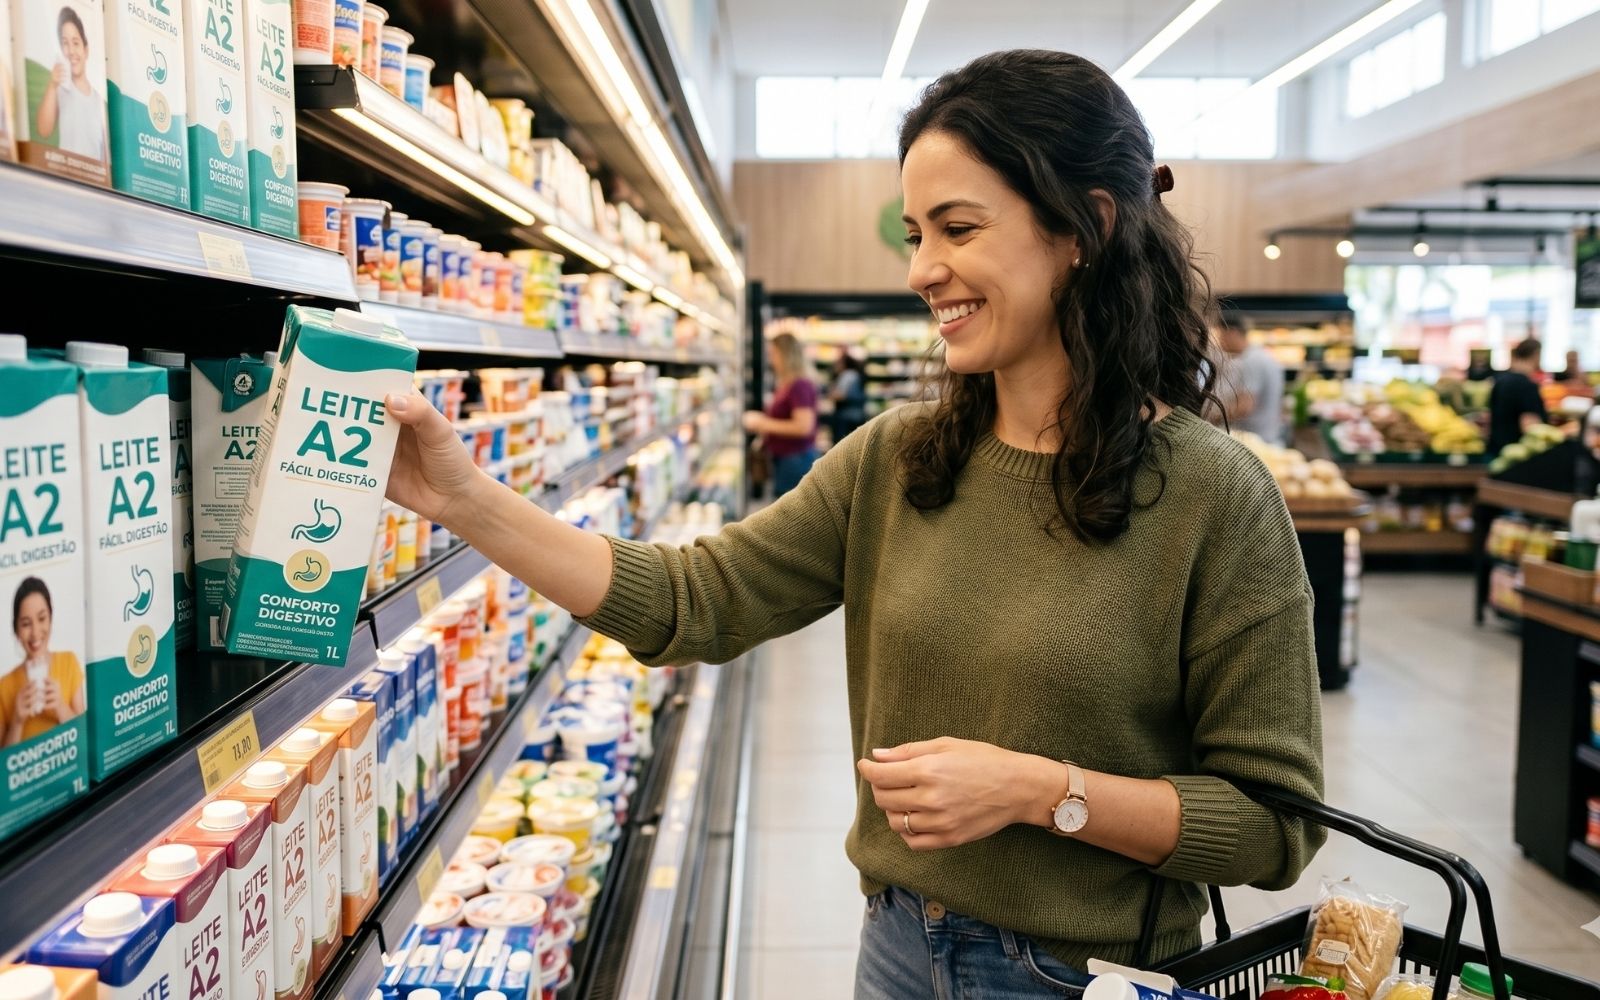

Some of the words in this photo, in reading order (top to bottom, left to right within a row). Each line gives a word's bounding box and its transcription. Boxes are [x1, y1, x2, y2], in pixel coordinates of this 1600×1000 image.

[205, 7, 234, 53] A2
[256, 14, 285, 48] LEITE
[261, 42, 285, 82] A2
[138, 132, 182, 155] CONFORTO
[139, 147, 182, 169] DIGESTIVO
[208, 158, 244, 178] CONFORTO
[301, 387, 386, 426] LEITE
[170, 419, 191, 440] LEI
[296, 420, 372, 468] A2
[0, 443, 67, 480] EITE
[100, 436, 160, 471] LEITE
[224, 440, 257, 460] A2
[280, 460, 314, 477] FÁCIL
[316, 468, 378, 488] DIGESTÃO
[0, 482, 64, 543] A2
[108, 470, 158, 525] A2
[100, 530, 126, 549] FÁCIL
[126, 521, 168, 543] DIGESTÃO
[258, 607, 336, 628] DIGESTIVO
[259, 593, 340, 615] CONFORTO
[326, 645, 340, 659] 1L
[112, 673, 169, 709] CONFORTO
[114, 689, 169, 726] DIGESTIVO
[165, 719, 175, 735] 1L
[6, 727, 78, 771] CONFORTO
[354, 752, 373, 780] LEITE
[8, 746, 78, 791] DIGESTIVO
[73, 776, 87, 795] 1L
[315, 785, 335, 818] LEITE
[354, 772, 373, 813] A2
[281, 821, 305, 860] LEITE
[318, 808, 336, 855] A2
[238, 864, 268, 911] LEITE
[284, 847, 305, 899] A2
[242, 893, 267, 952] A2
[184, 915, 221, 969] LEITE
[189, 946, 221, 1000] A2
